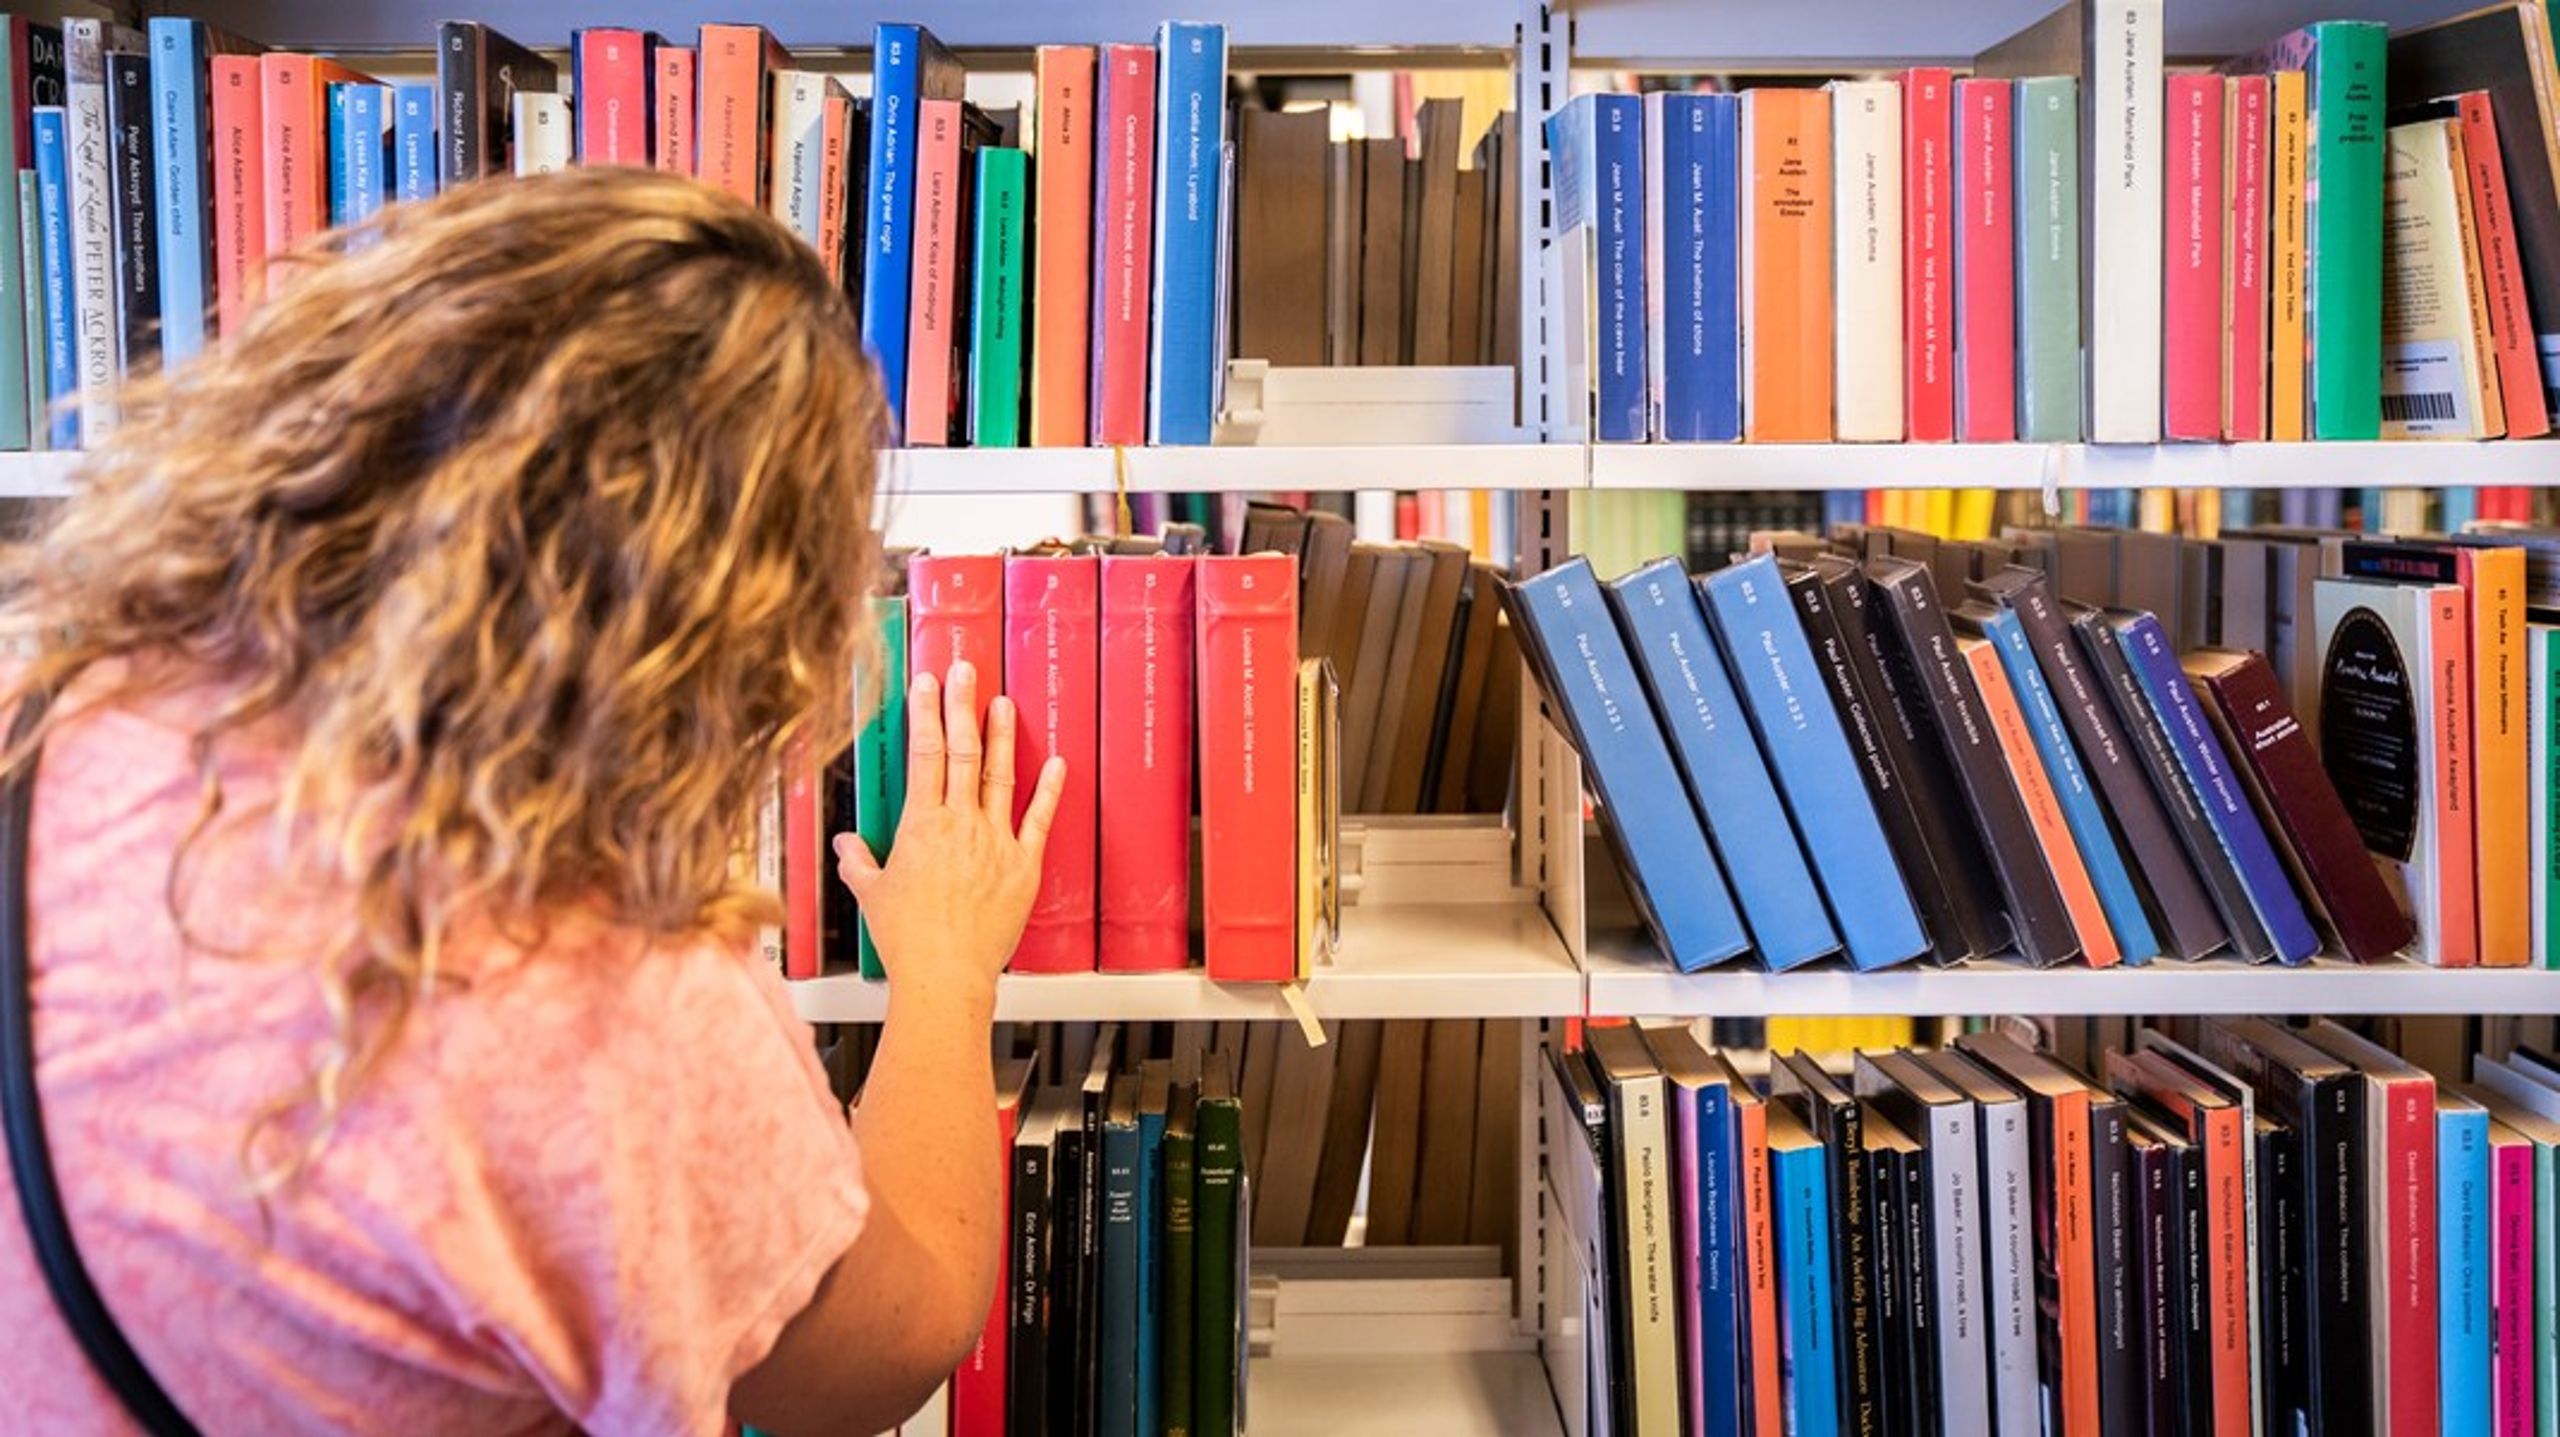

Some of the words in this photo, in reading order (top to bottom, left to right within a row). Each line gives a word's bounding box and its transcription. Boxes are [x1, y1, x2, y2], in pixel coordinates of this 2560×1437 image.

[2126, 10, 2136, 25] 83
[451, 37, 463, 52] 83
[1190, 38, 1202, 53] 83
[2125, 29, 2136, 58] Jane
[166, 91, 178, 123] Claire
[453, 91, 465, 137] Richard
[887, 94, 899, 125] Chris
[1611, 108, 1622, 132] 83.8
[1692, 108, 1703, 132] 83.8
[1125, 114, 1137, 157] Cecelia
[2124, 106, 2136, 161] Mansfield
[2191, 110, 2202, 138] Jane
[2246, 113, 2257, 141] Jane
[128, 126, 141, 155] Peter
[1611, 162, 1623, 190] Jean
[1692, 162, 1704, 190] Jean
[1866, 153, 1876, 179] Jane
[2048, 150, 2061, 178] Jane
[2124, 163, 2136, 190] Park
[169, 165, 181, 206] Golden
[404, 169, 421, 192] Kay
[885, 171, 896, 192] The
[932, 171, 943, 195] Lara
[881, 194, 894, 222] great
[1124, 200, 1135, 221] The
[1613, 192, 1624, 205] M.
[1693, 192, 1703, 205] M.
[134, 211, 145, 242] Three
[172, 208, 183, 236] child
[2191, 186, 2202, 241] Mansfield
[2243, 187, 2256, 251] Northanger
[880, 224, 894, 253] night
[1123, 223, 1134, 251] book
[1614, 239, 1625, 261] The
[1693, 239, 1704, 261] The
[1868, 227, 1878, 262] Emma
[2050, 225, 2062, 262] Emma
[930, 241, 941, 265] Kiss
[1123, 253, 1133, 267] of
[2191, 242, 2202, 269] Park
[135, 245, 147, 293] brothers
[929, 267, 940, 280] of
[1615, 263, 1625, 285] clan
[2241, 252, 2254, 288] Abbey
[1615, 287, 1626, 301] of
[1693, 263, 1704, 306] shelters
[925, 281, 939, 330] midnight
[1616, 302, 1626, 320] the
[1693, 308, 1704, 322] of
[1616, 323, 1626, 348] cave
[1693, 324, 1704, 356] stone
[1616, 350, 1627, 376] bear
[1145, 572, 1156, 588] 83
[1241, 574, 1253, 590] 83
[1144, 606, 1156, 644] Louisa
[1145, 646, 1156, 660] M.
[1243, 627, 1254, 666] Louisa
[1576, 633, 1593, 659] Paul
[1761, 630, 1777, 657] Paul
[1145, 662, 1156, 697] Alcott:
[1243, 668, 1255, 682] M.
[1243, 684, 1255, 720] Alcott:
[1825, 637, 1841, 663] Paul
[1850, 702, 1877, 753] Collected
[1931, 635, 1947, 660] Paul
[1957, 700, 1980, 744] Invisible
[1145, 699, 1156, 728] Little
[2055, 642, 2073, 667] Paul
[2085, 703, 2108, 742] Sunset
[2104, 738, 2120, 766] Park
[1145, 730, 1154, 769] women
[1243, 722, 1255, 752] Little
[2167, 678, 2185, 704] Paul
[2197, 740, 2219, 781] Winter
[2212, 776, 2238, 815] journal
[1244, 753, 1253, 794] women
[1638, 1094, 1649, 1117] 83.8
[1844, 1121, 1859, 1155] Beryl
[1950, 1121, 1960, 1136] 83
[1025, 1160, 1036, 1175] 83
[1085, 1151, 1095, 1186] American
[1641, 1147, 1652, 1178] Paolo
[2338, 1142, 2348, 1172] David
[2407, 1151, 2418, 1182] David
[1951, 1172, 1962, 1187] Jo
[2006, 1170, 2017, 1185] Jo
[1845, 1159, 1861, 1225] Bainbridge
[2111, 1171, 2122, 1226] Nicholson
[2222, 1176, 2234, 1231] Nicholson
[1025, 1211, 1037, 1233] Eric
[1954, 1225, 1964, 1235] A
[2009, 1224, 2019, 1233] A
[1083, 1223, 1093, 1256] literature
[1851, 1233, 1862, 1252] An
[2340, 1228, 2350, 1248] The
[1647, 1242, 1658, 1264] The
[1951, 1235, 1965, 1277] country
[2006, 1233, 2020, 1274] country
[2408, 1237, 2420, 1281] Memory
[1025, 1281, 1036, 1294] Dr
[1648, 1265, 1658, 1294] water
[1851, 1255, 1864, 1303] Awfully
[2114, 1267, 2125, 1287] The
[2225, 1270, 2236, 1305] House
[2340, 1250, 2350, 1302] collectors
[1649, 1295, 1660, 1323] knife
[2410, 1284, 2419, 1307] man
[1023, 1295, 1036, 1325] Frigo
[1853, 1306, 1867, 1329] Big
[2112, 1287, 2126, 1350] anthologist
[2226, 1306, 2237, 1318] of
[1958, 1316, 1968, 1340] tree
[2012, 1314, 2022, 1338] tree
[2226, 1320, 2237, 1350] holes
[1855, 1331, 1870, 1395] Adventure
